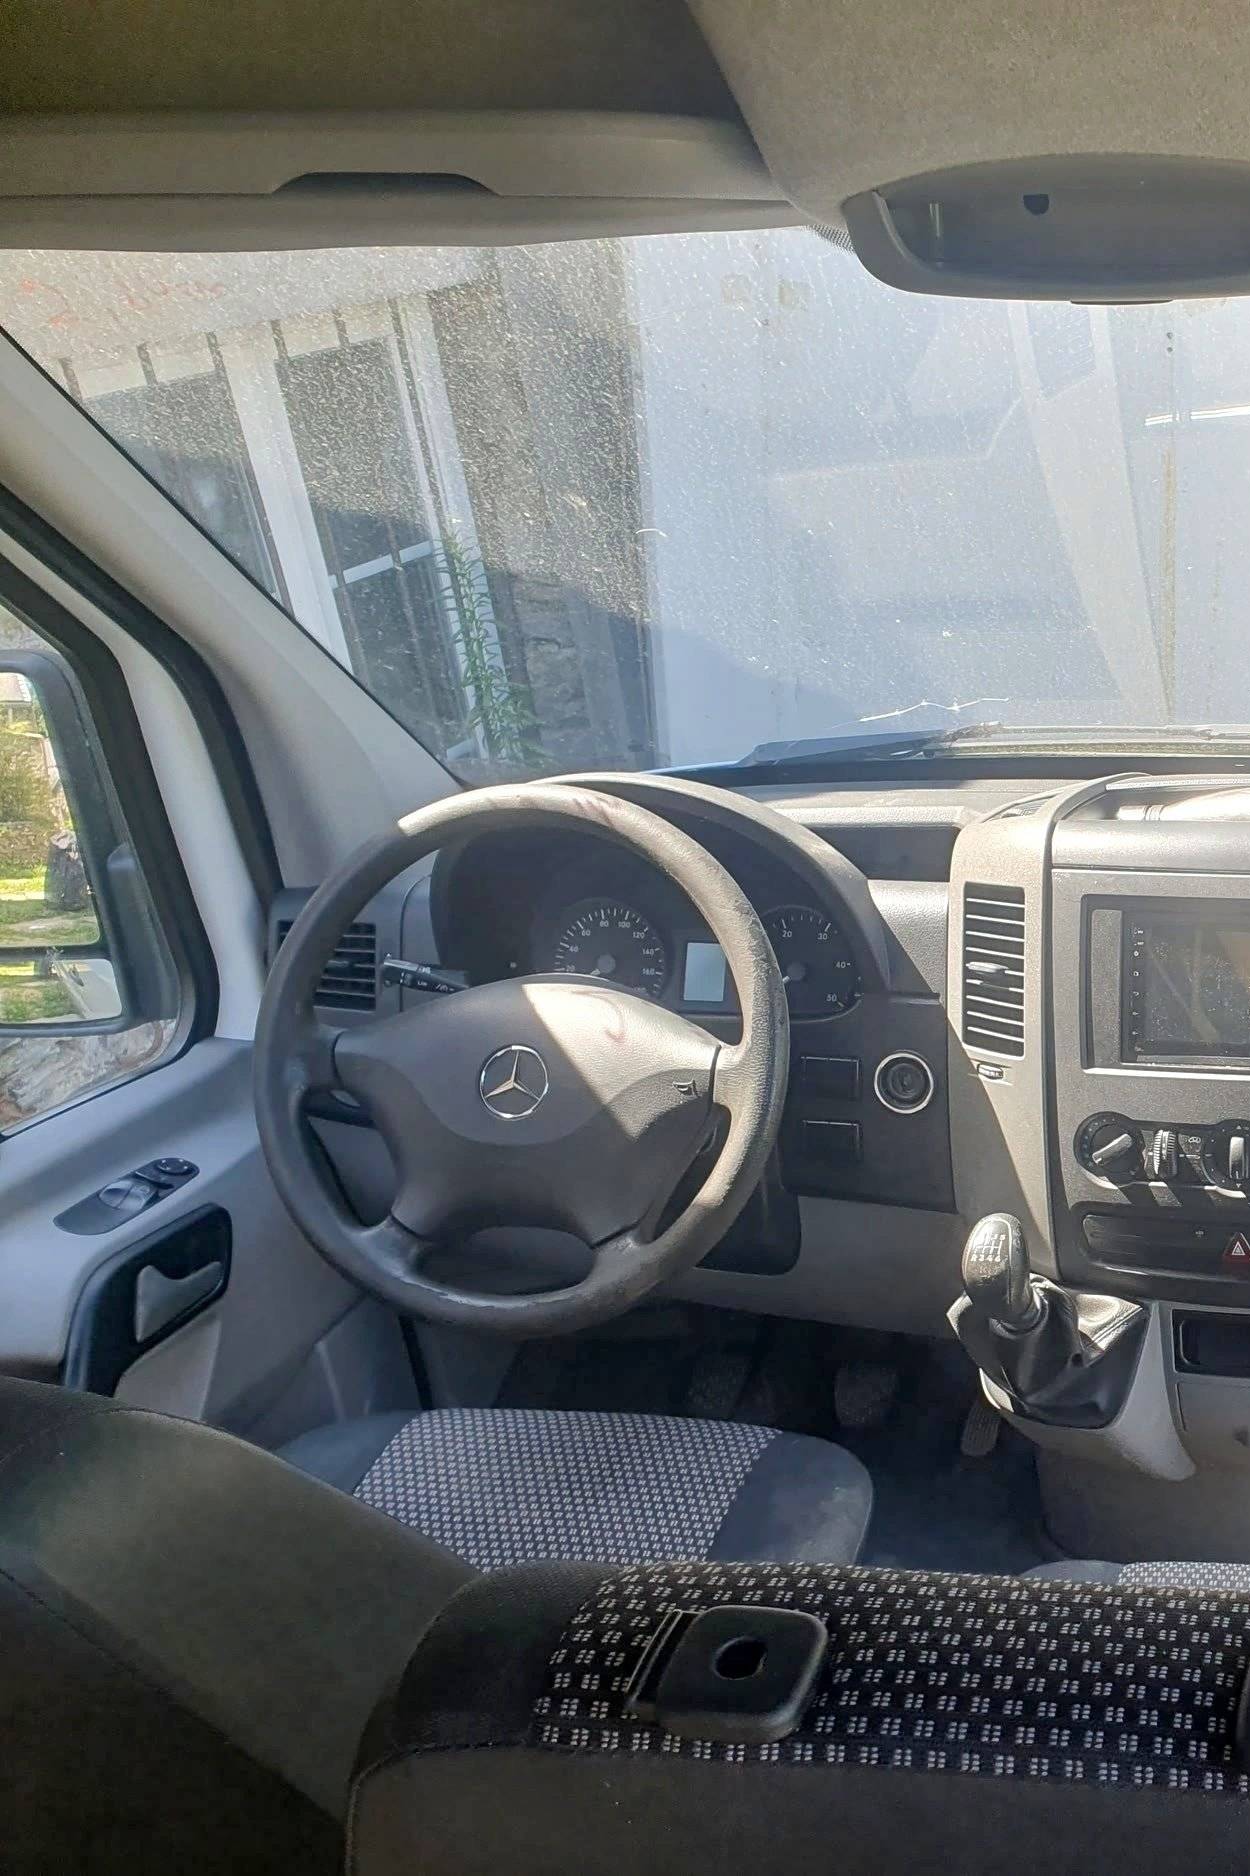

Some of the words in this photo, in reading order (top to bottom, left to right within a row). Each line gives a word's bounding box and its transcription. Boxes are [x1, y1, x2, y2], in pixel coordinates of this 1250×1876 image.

[618, 920, 631, 928] 100
[633, 931, 645, 939] 120
[782, 930, 793, 938] 20
[826, 993, 837, 1002] 50
